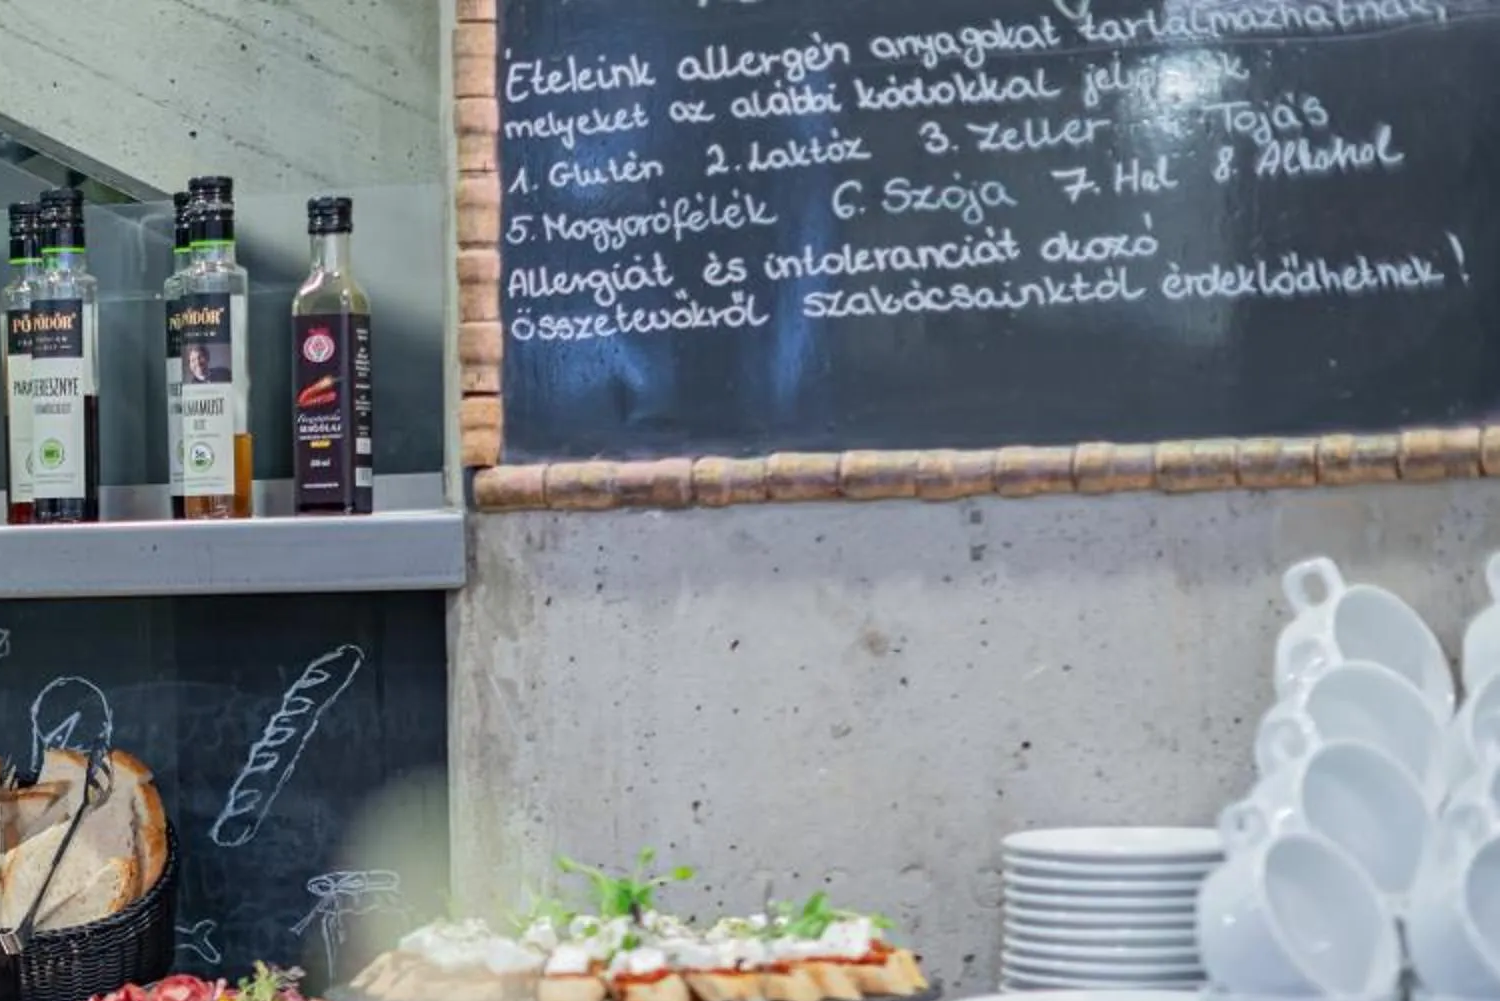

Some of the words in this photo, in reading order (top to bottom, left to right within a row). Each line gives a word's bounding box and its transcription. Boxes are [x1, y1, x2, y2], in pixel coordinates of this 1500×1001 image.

[870, 15, 1061, 69] anyagokat
[504, 102, 649, 150] melyeket
[669, 99, 716, 123] az
[505, 215, 536, 244] 5.
[831, 179, 866, 220] 6.
[1050, 166, 1100, 204] 7.
[1113, 154, 1180, 194] Hal
[1213, 145, 1238, 183] 8.
[1256, 123, 1405, 177] Alkohol
[508, 167, 539, 195] 1.
[706, 144, 742, 176] 2.
[917, 121, 959, 153] 3.
